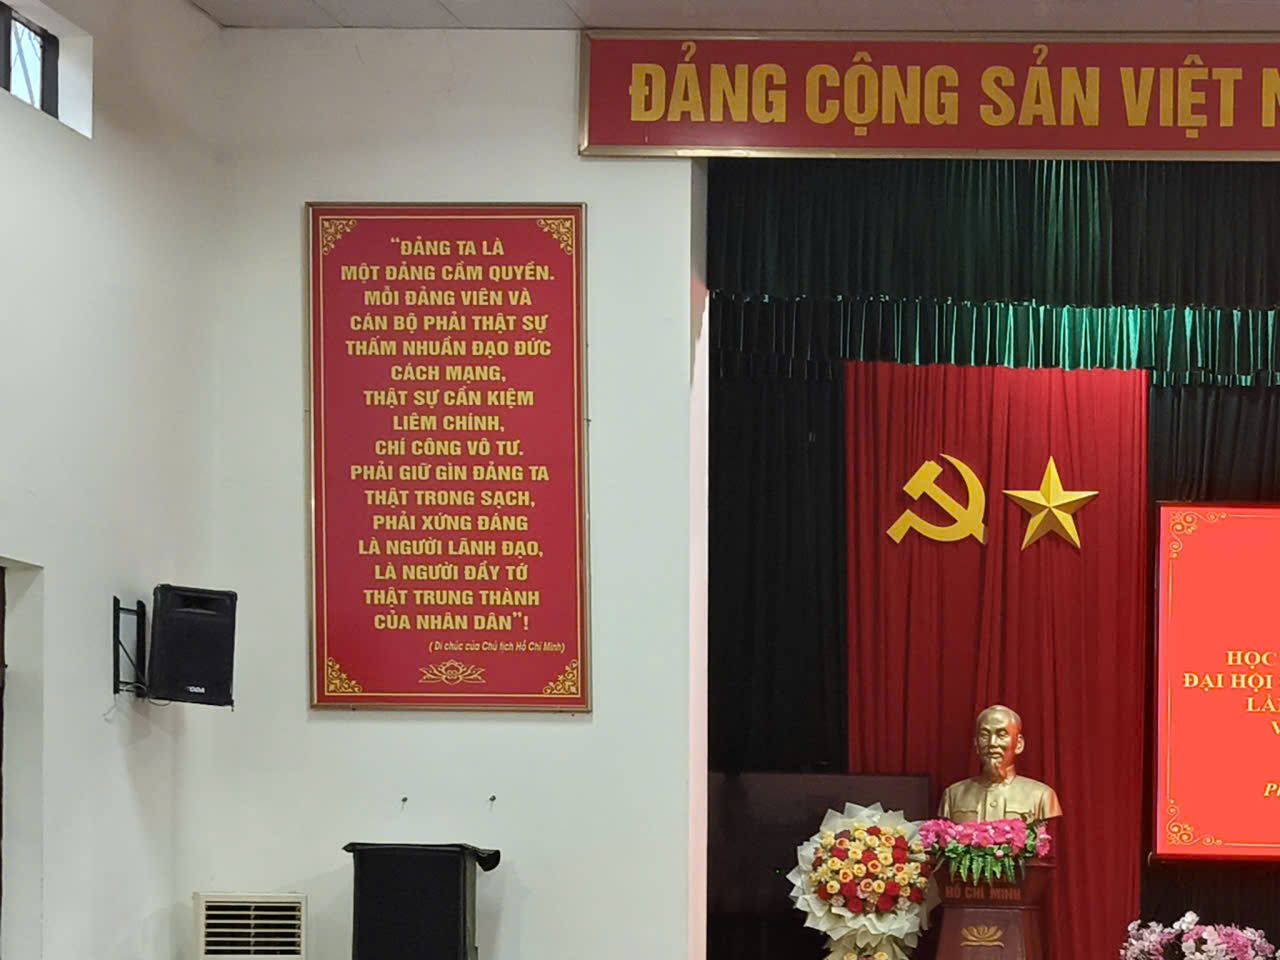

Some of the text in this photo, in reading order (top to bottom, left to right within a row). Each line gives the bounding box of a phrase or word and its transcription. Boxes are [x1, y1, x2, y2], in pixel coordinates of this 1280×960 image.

[629, 41, 788, 124] ĐẢNG
[805, 50, 959, 136] CỘNG
[979, 44, 1100, 127] SẢN
[1119, 54, 1243, 139] VIỆT
[391, 236, 504, 256] “ĐẢNG TA LÀ
[341, 261, 435, 283] MỘT ĐẢNG
[405, 285, 532, 306] ĐẢNG VIÊN VÀ
[350, 311, 549, 334] CÁN BỘ PHẢI THẬT SỰ
[472, 340, 509, 359] ĐẠO
[514, 337, 551, 356] ĐỨC
[391, 362, 506, 384] CÁCH MẠNG,
[363, 387, 534, 409] THẬT SỰ KIỆM
[393, 412, 505, 432] LIÊM CHÍNH,
[375, 437, 524, 456] CHÍ CÔNG VÔ TƯ.
[351, 460, 549, 481] PHẢI GIỮ GÌN ĐẢNG TA
[364, 487, 535, 509] THẬT TRONG SẠCH,
[373, 510, 528, 531] PHẢI XỨNG ĐÁNG
[359, 536, 543, 559] LÀ NGƯỜI LÃNH ĐẠO,
[375, 561, 528, 581] LÀ NGƯỜI TỚ
[363, 586, 540, 608] THẬT TRUNG THÀNH
[374, 610, 411, 629] CỦA
[416, 612, 468, 630] NHÂN
[1227, 651, 1277, 669] HỌC
[1184, 673, 1223, 691] ĐẠI
